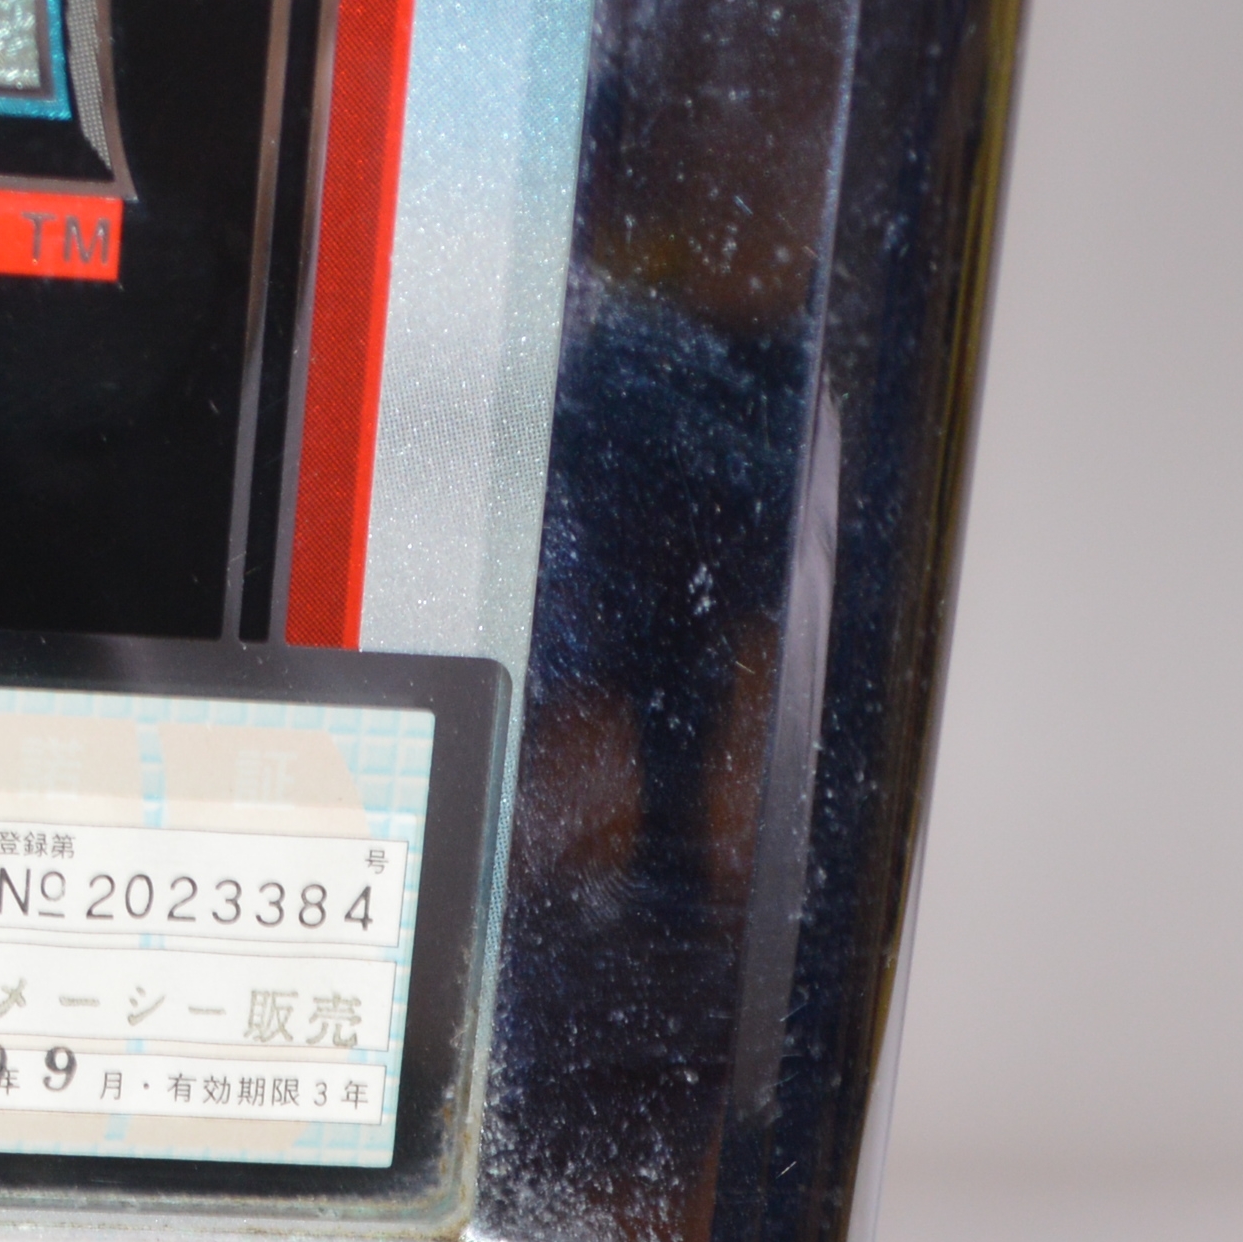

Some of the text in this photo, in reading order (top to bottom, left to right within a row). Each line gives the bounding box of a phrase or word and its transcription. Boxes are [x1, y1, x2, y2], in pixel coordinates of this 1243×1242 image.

[21, 211, 111, 265] TM
[365, 848, 389, 875] 号
[86, 873, 374, 931] 2023384
